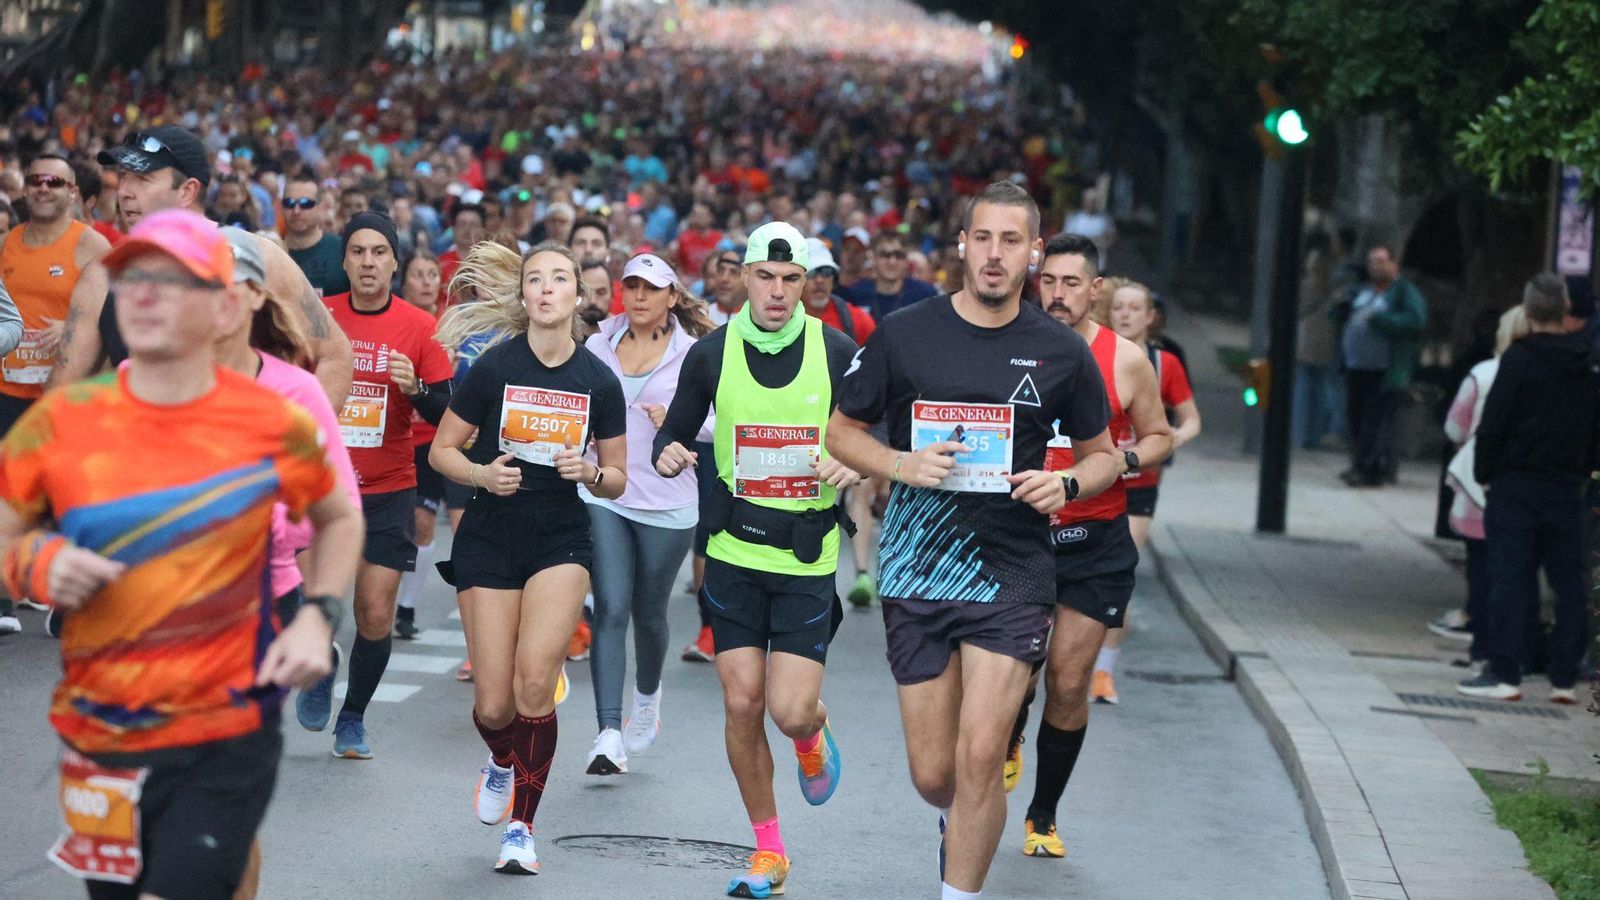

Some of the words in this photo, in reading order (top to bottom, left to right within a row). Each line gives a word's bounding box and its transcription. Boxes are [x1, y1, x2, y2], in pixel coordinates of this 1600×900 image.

[349, 386, 380, 397] ERALI
[528, 391, 582, 410] GENERALI
[339, 405, 368, 418] 751
[939, 406, 1005, 421] GENERALI
[521, 414, 570, 434] 12507
[758, 428, 813, 440] GENERAL
[759, 451, 797, 467] 1845
[742, 524, 767, 537] KIPRUN
